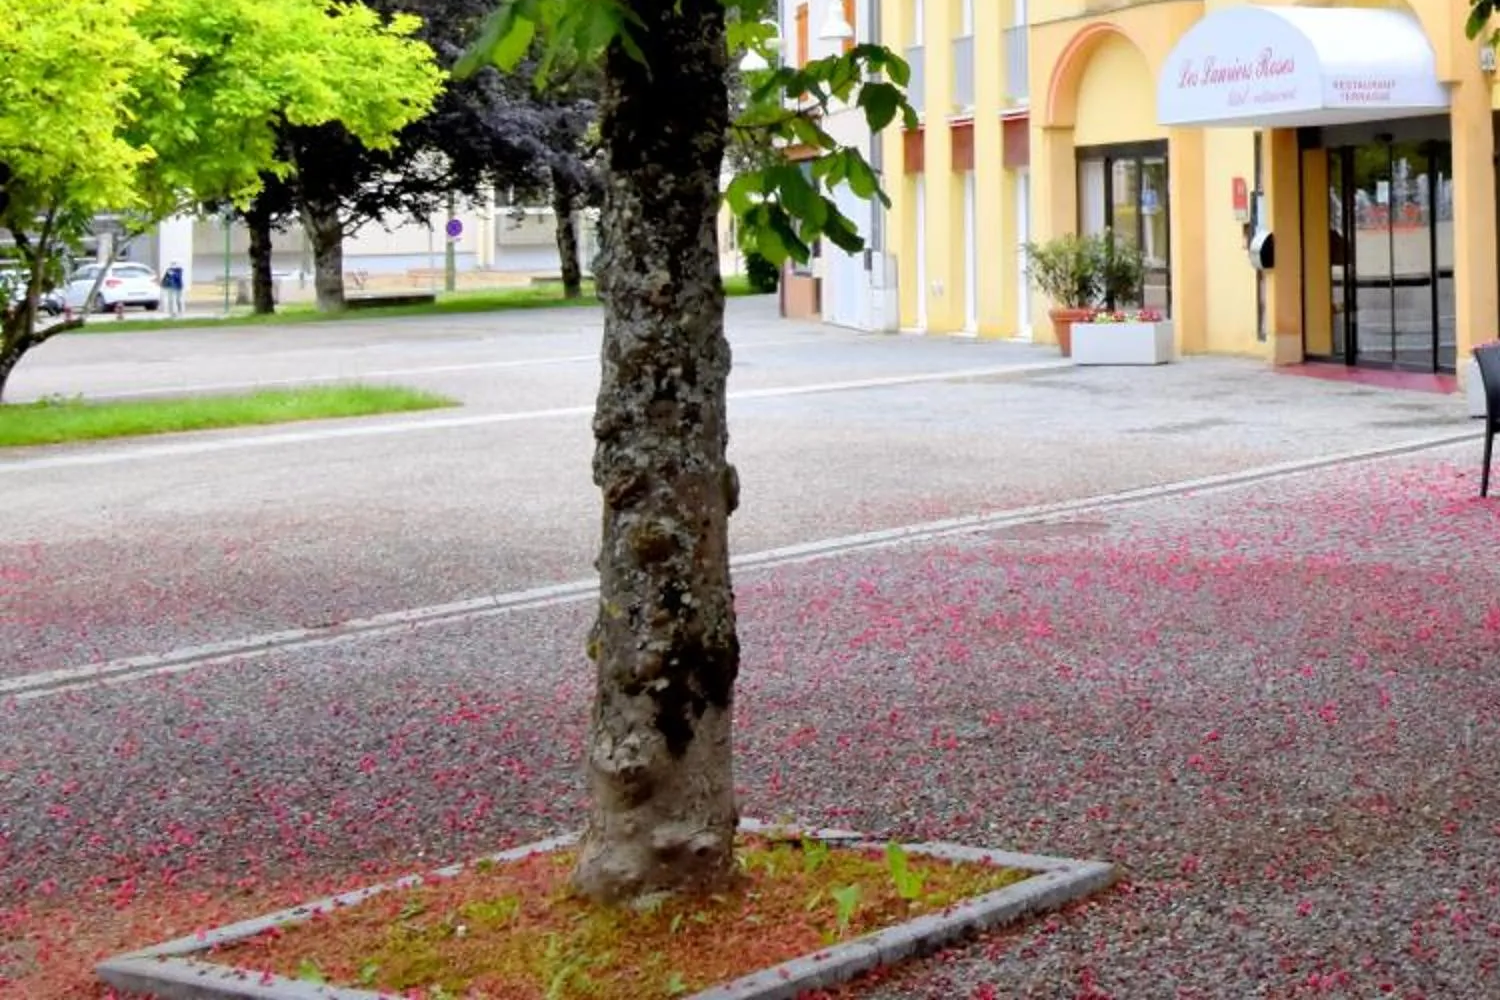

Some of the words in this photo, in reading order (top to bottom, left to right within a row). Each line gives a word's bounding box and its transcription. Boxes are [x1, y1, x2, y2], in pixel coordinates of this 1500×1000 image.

[1178, 58, 1198, 88] Les
[1200, 55, 1252, 85] Lauriers
[1255, 47, 1295, 79] Roses
